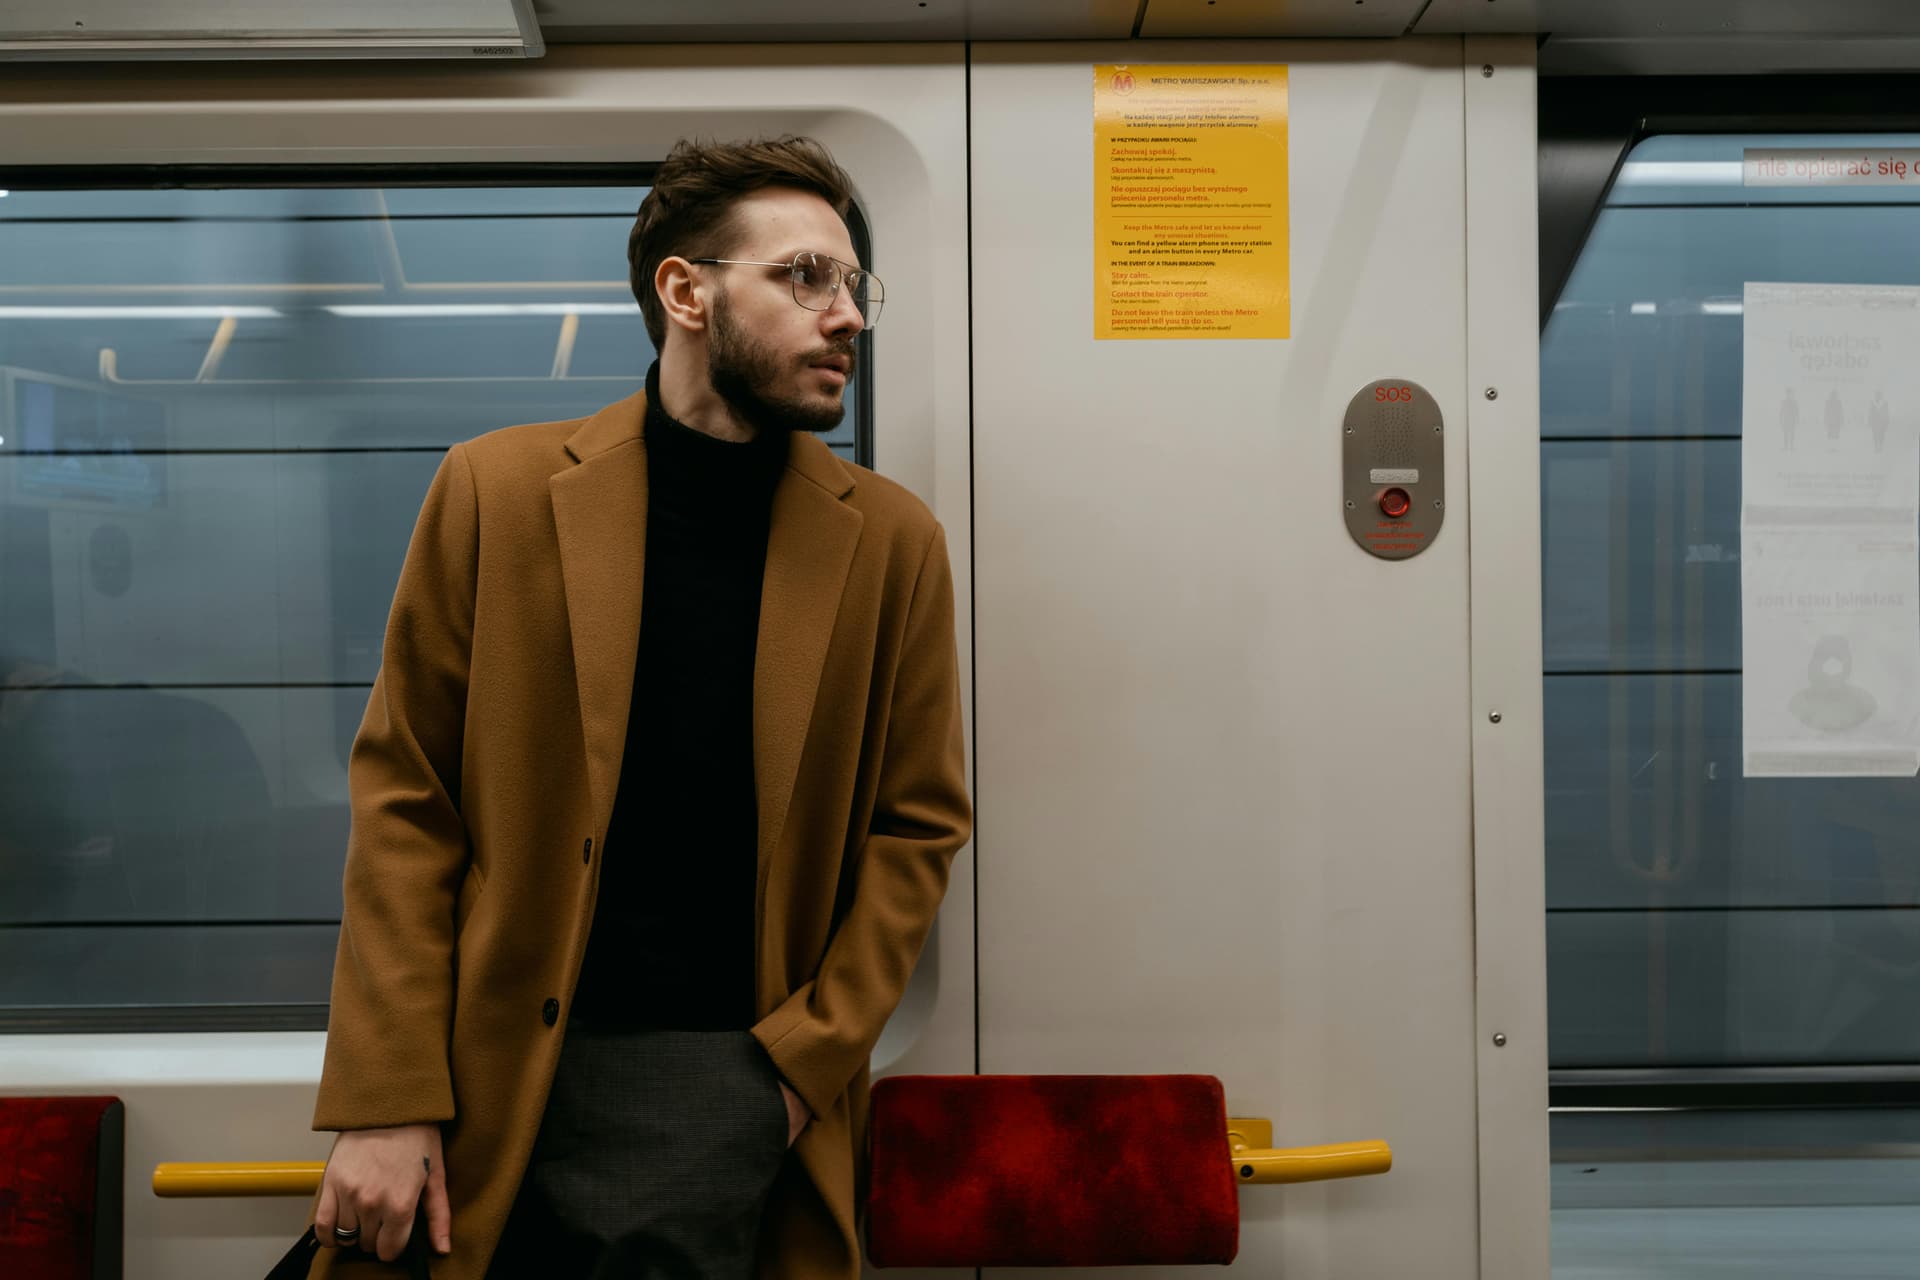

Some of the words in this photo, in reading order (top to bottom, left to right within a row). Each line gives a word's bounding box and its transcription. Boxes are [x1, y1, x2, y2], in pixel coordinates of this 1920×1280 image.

[1114, 75, 1132, 90] M
[1111, 166, 1152, 175] Skontaktuj
[1155, 166, 1164, 175] się
[1758, 156, 1787, 176] nie
[1795, 156, 1871, 181] opierać
[1878, 156, 1907, 180] się
[1111, 272, 1128, 280] Stay
[1175, 291, 1208, 299] operator.
[1375, 386, 1412, 402] SOS
